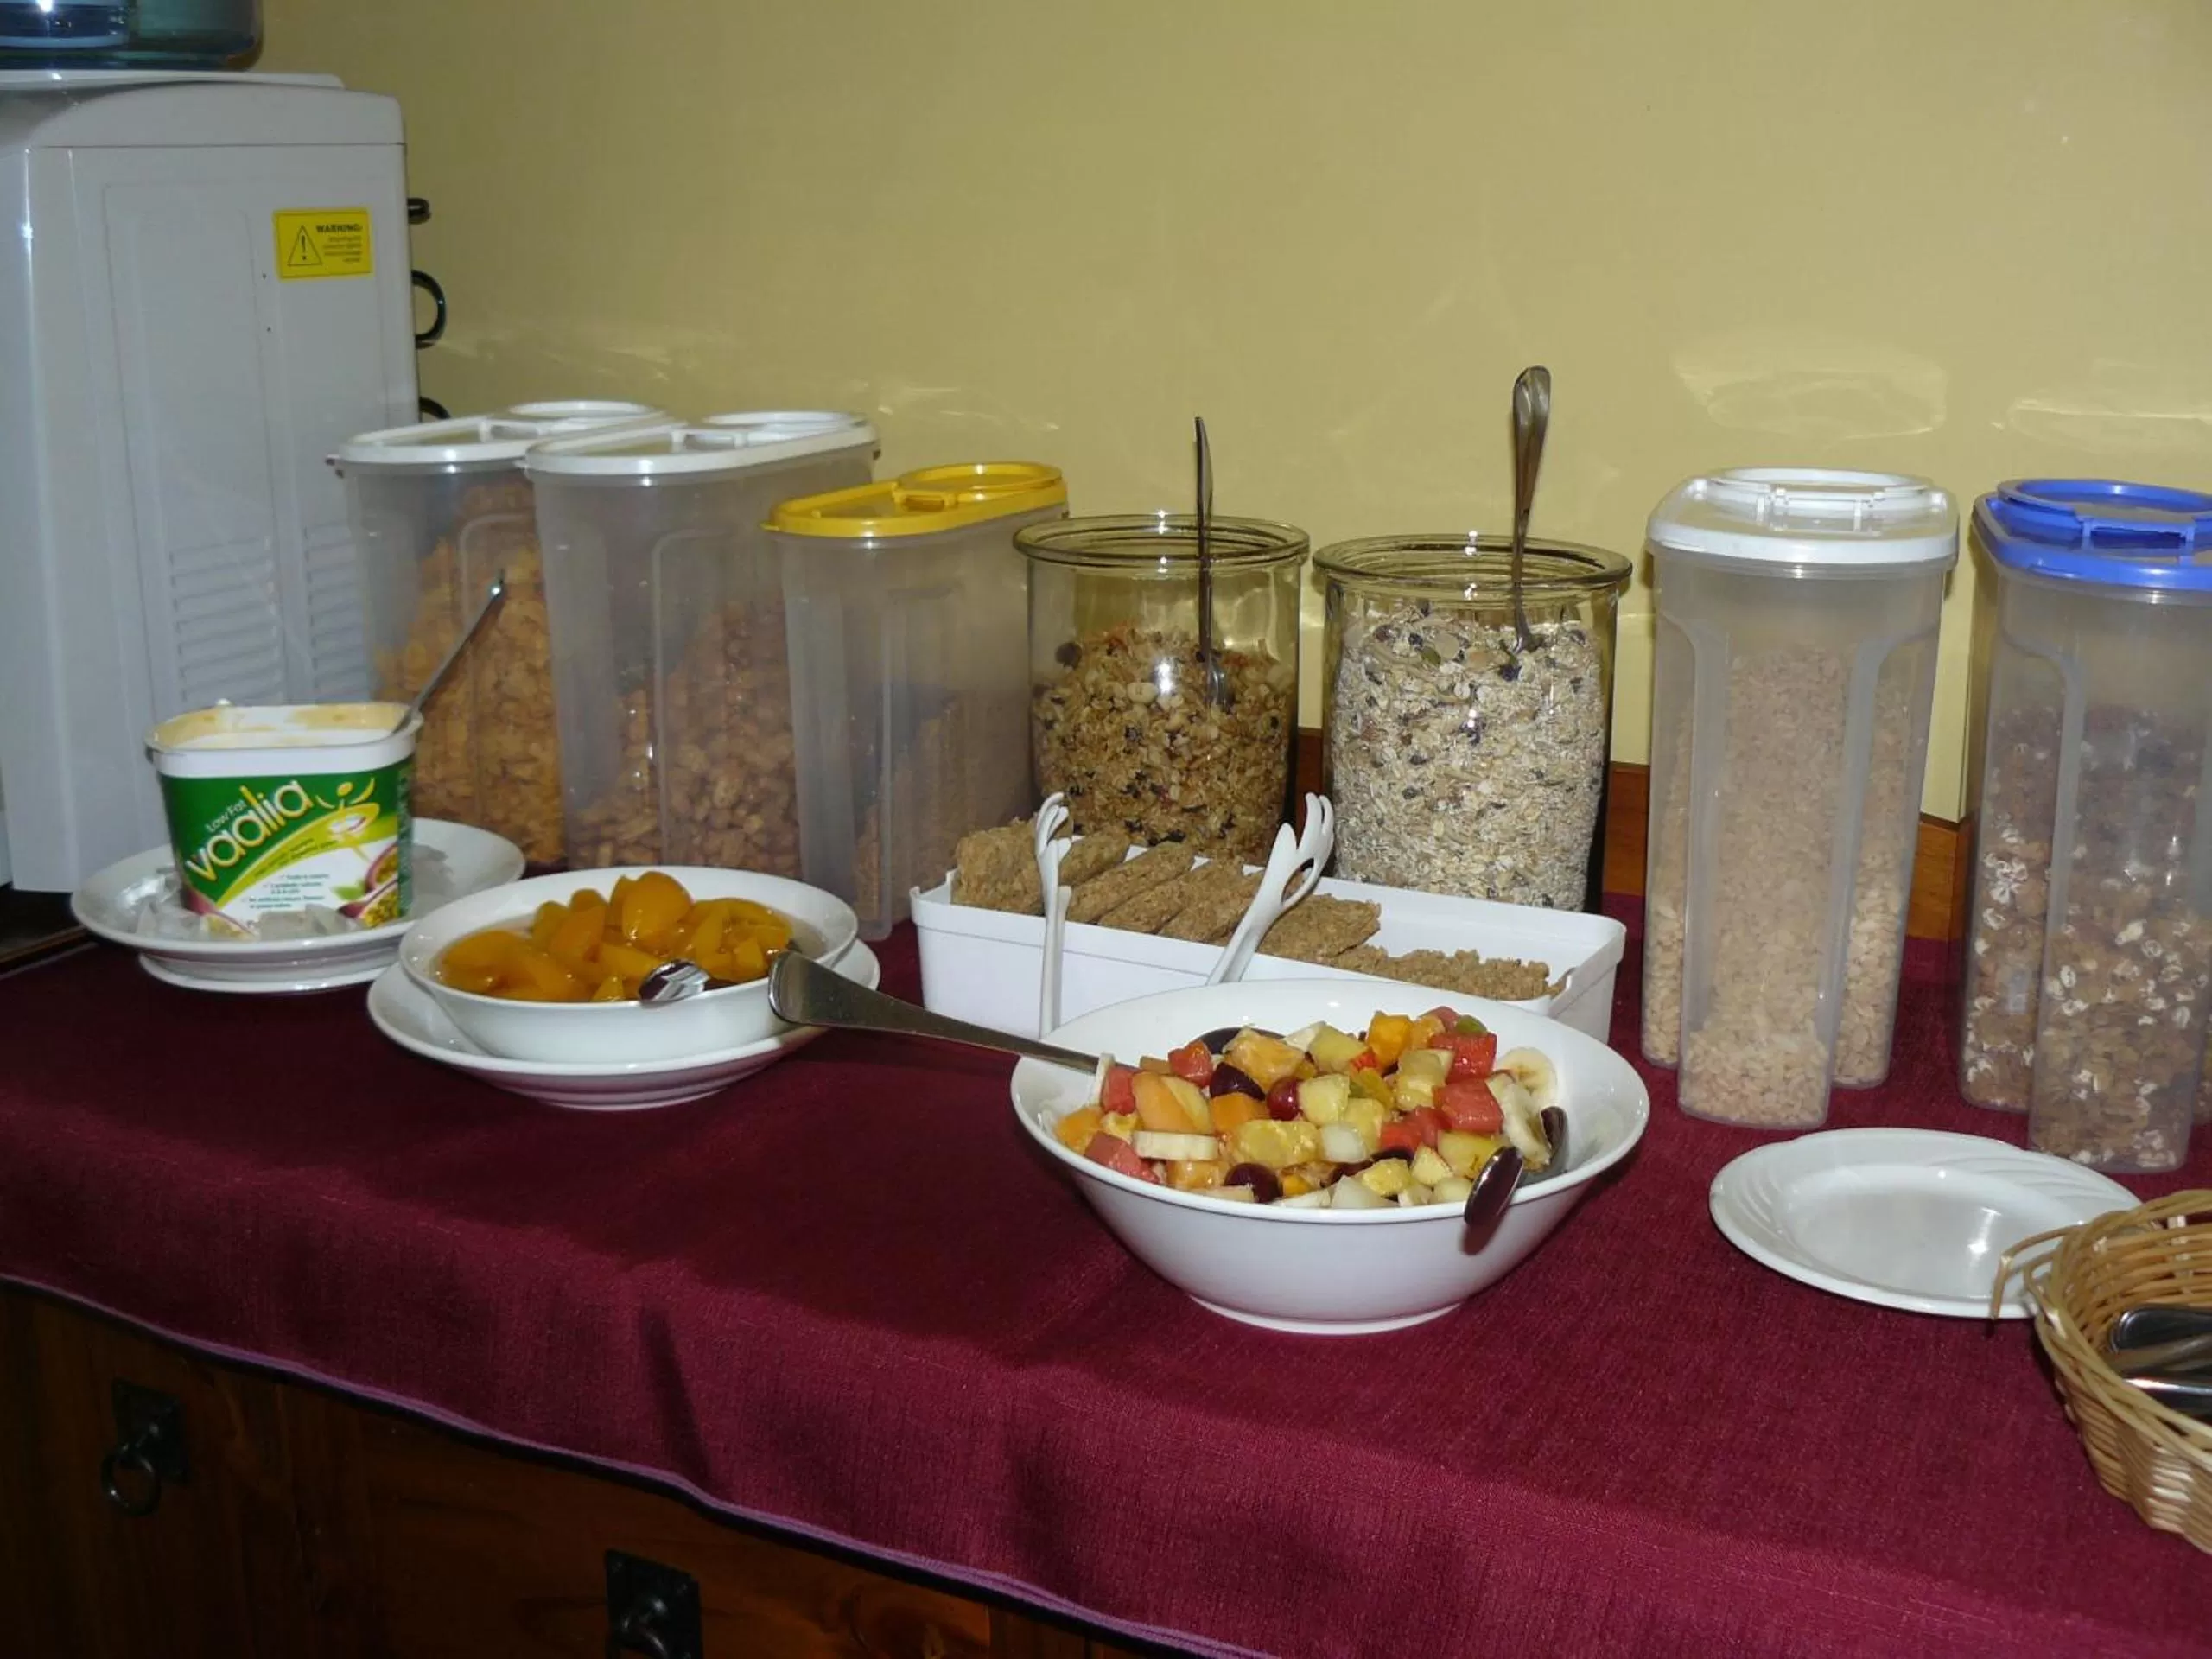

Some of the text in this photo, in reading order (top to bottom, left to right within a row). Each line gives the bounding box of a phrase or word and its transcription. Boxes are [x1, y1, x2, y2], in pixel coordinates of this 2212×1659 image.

[186, 781, 314, 880] vaalia
[205, 800, 247, 832] Low Fat
